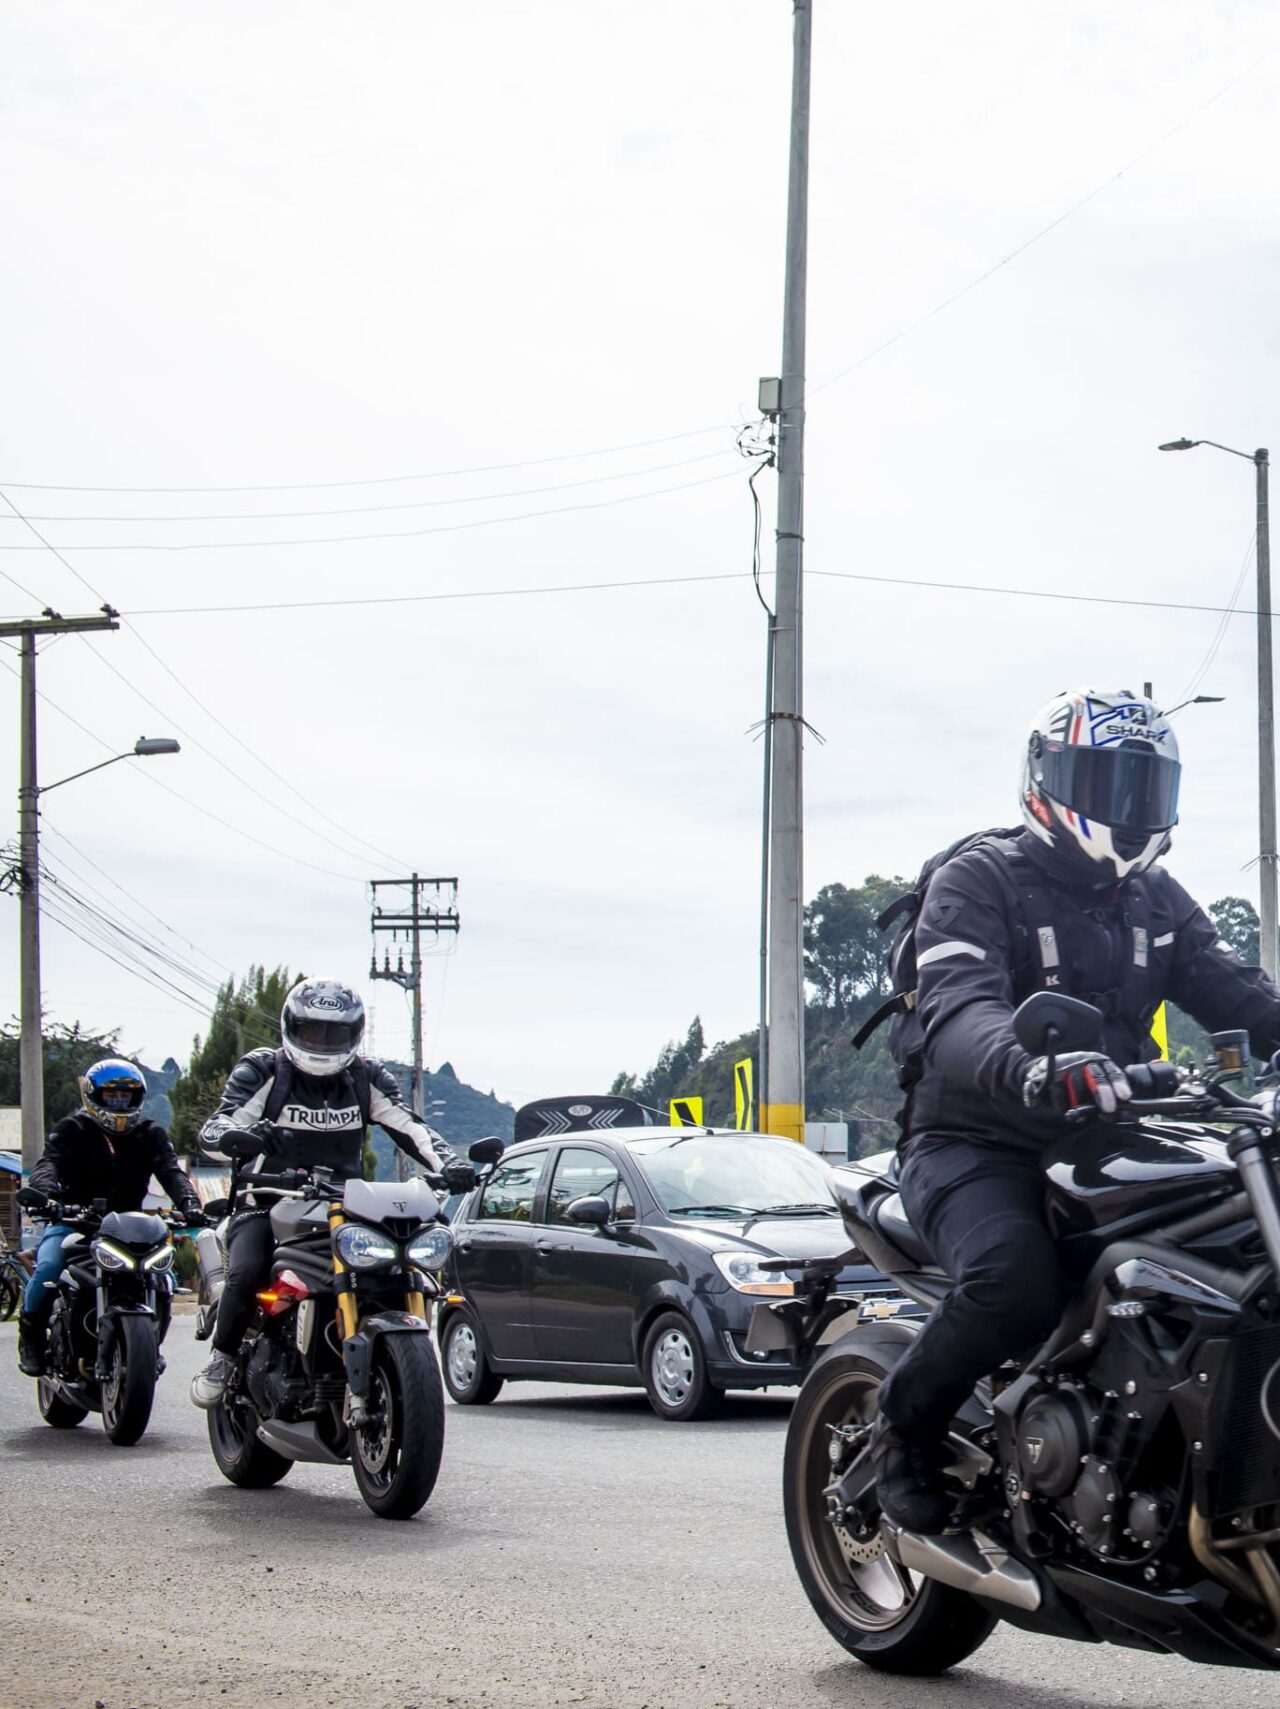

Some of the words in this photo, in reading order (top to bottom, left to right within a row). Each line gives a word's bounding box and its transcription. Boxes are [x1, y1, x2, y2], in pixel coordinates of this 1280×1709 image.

[1106, 724, 1167, 745] SHARK
[313, 997, 339, 1008] Arai
[287, 1106, 361, 1127] TRIUMPH
